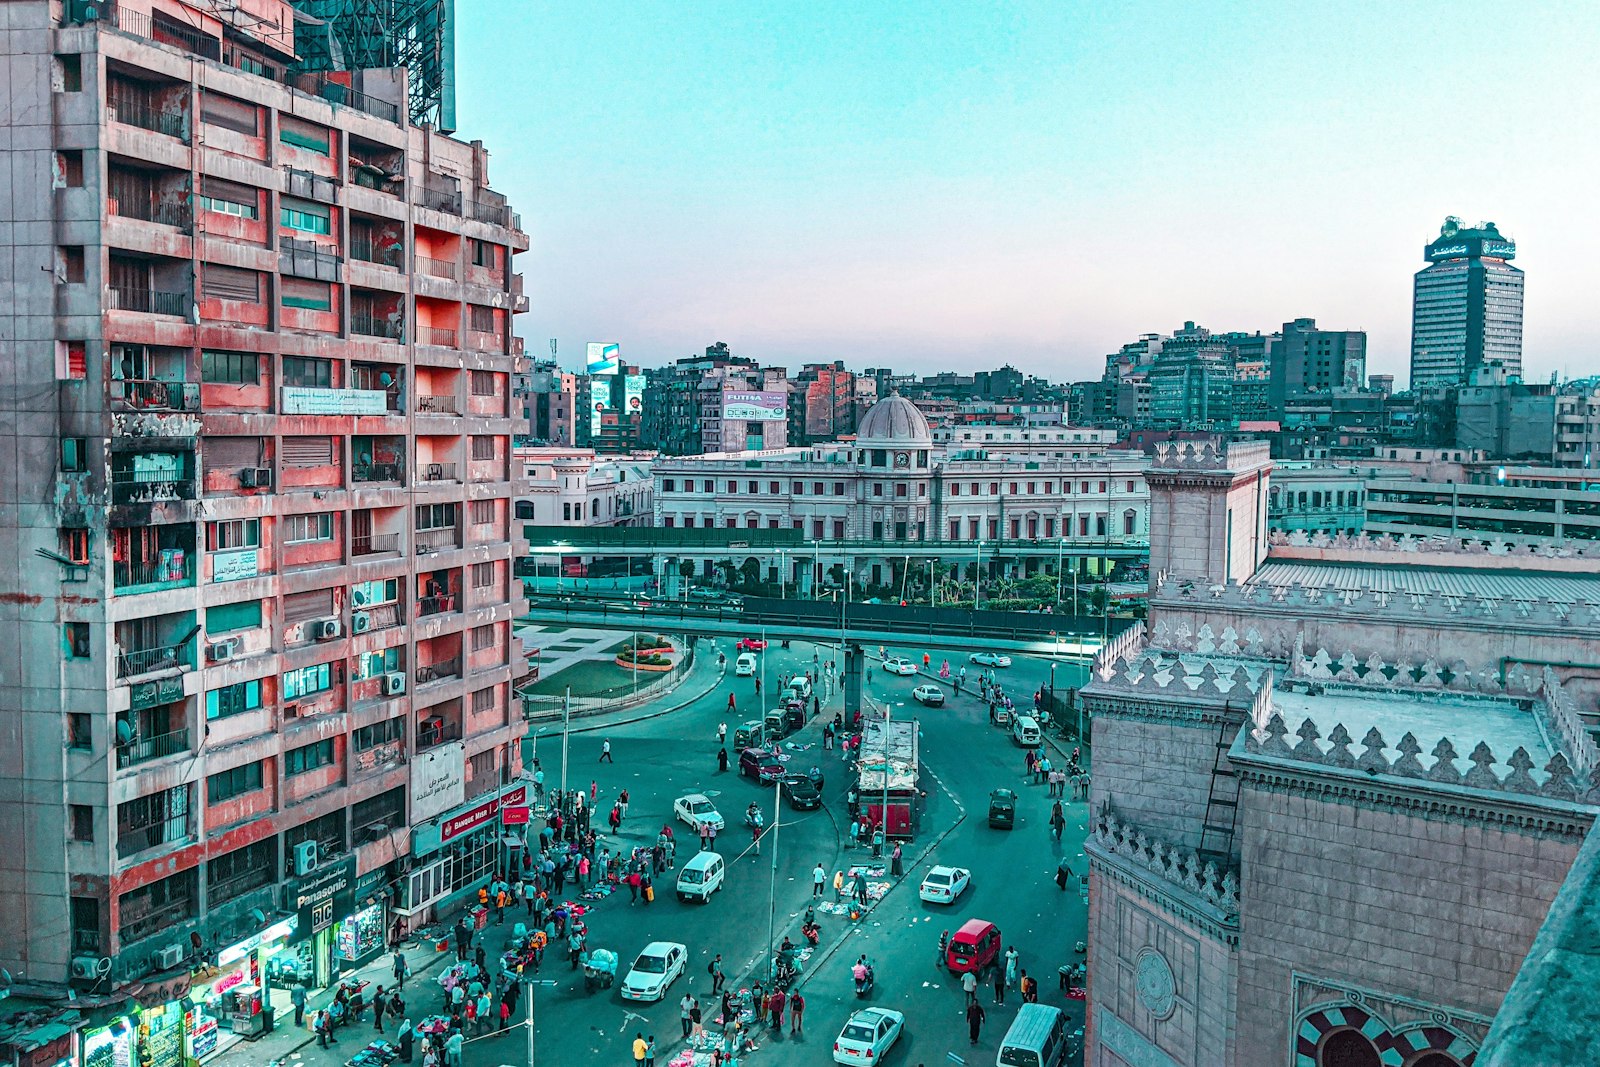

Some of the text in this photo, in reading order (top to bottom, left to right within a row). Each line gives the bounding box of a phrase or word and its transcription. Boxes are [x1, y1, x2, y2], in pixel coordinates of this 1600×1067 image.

[454, 809, 488, 830] BANQUE MISR
[297, 878, 347, 909] Panasonic
[313, 902, 332, 927] BTC
